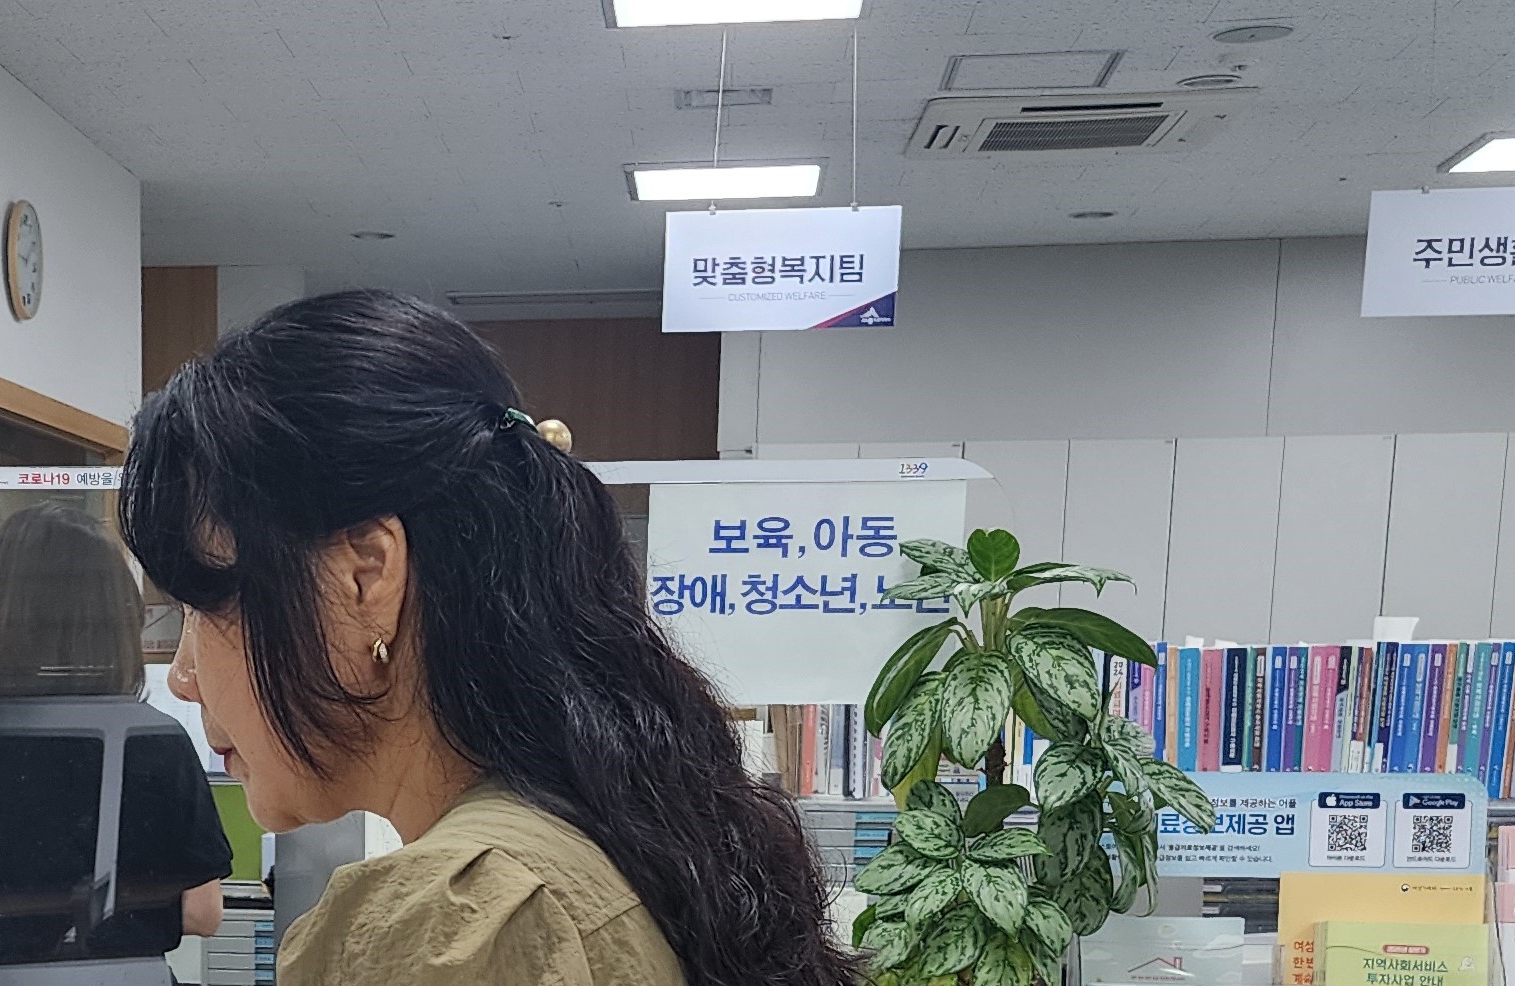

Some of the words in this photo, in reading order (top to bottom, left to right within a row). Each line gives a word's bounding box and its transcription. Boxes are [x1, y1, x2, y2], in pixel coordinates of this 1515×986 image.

[1413, 236, 1515, 269] 주민생
[692, 254, 864, 286] 맞춤형복지팀
[1450, 275, 1485, 285] PUBLIC
[1487, 274, 1515, 284] WELF
[728, 292, 783, 302] CUSTOMIZED
[786, 291, 826, 301] WELFARE
[18, 472, 71, 485] 코로나19
[76, 472, 114, 486] 예방을
[1240, 798, 1276, 808] 제공하는
[1273, 813, 1296, 836] 앱
[1363, 958, 1448, 973] 지역사회서비스
[1367, 973, 1414, 986] 투자사업
